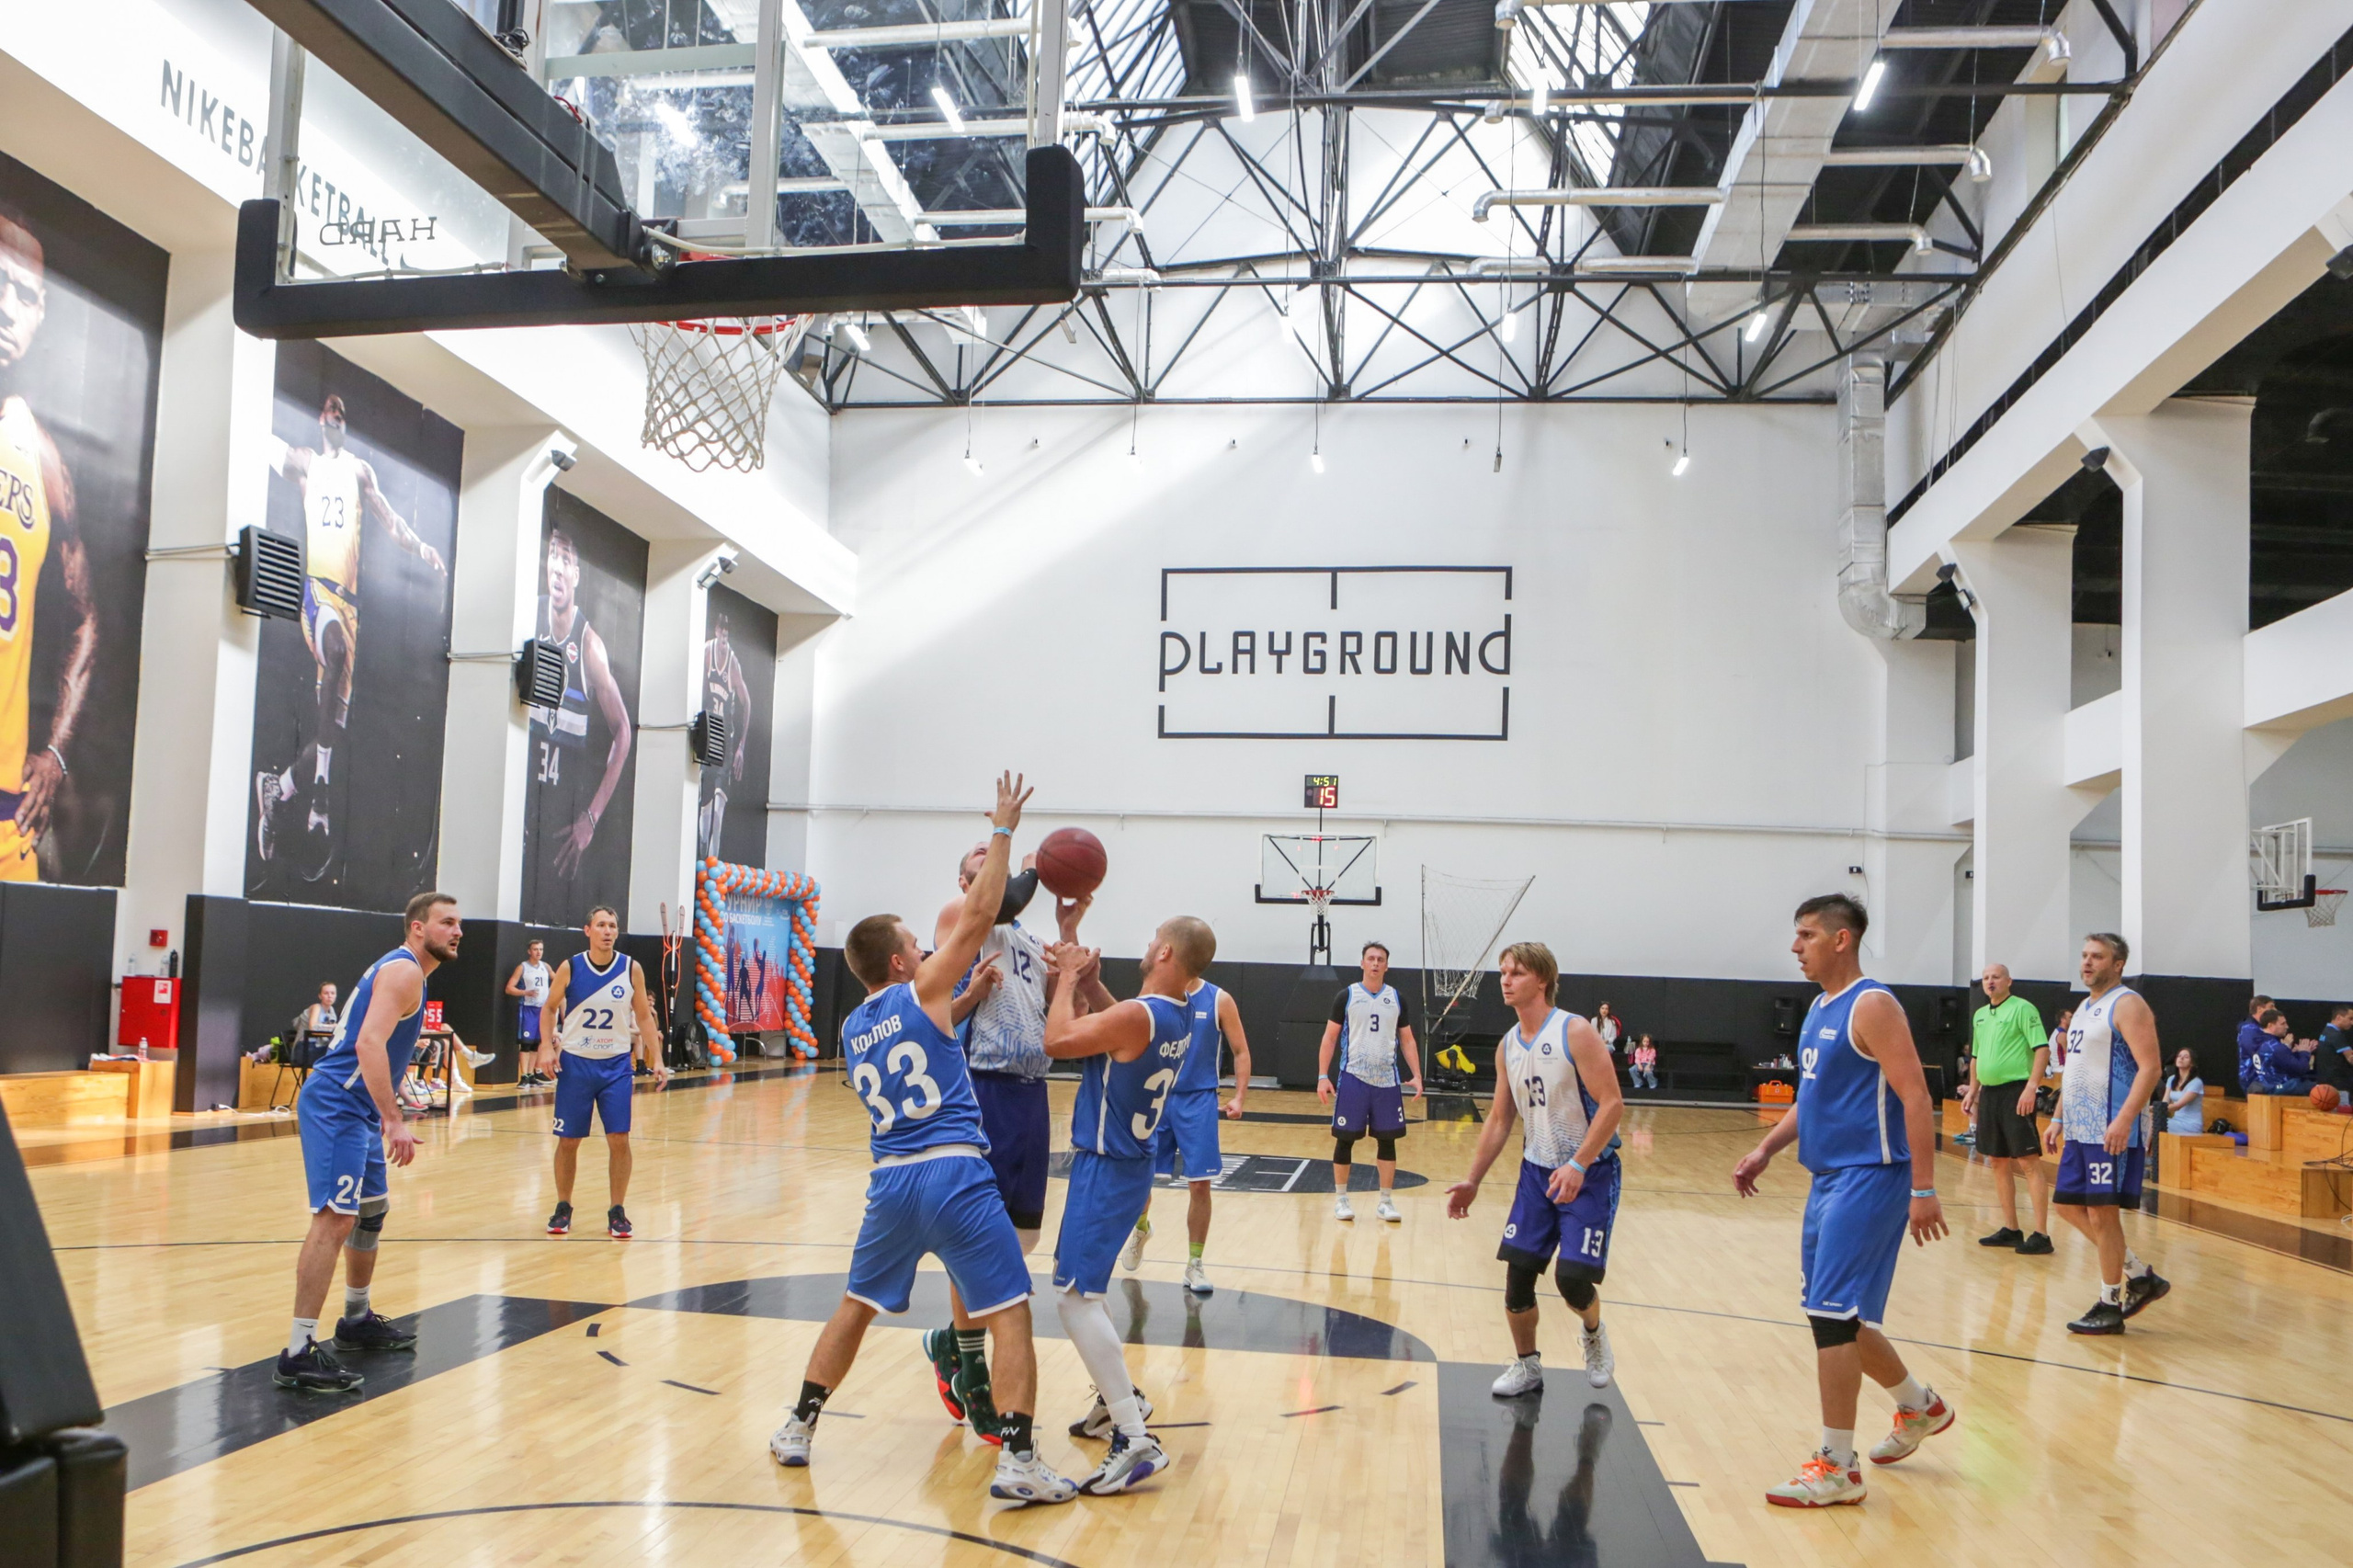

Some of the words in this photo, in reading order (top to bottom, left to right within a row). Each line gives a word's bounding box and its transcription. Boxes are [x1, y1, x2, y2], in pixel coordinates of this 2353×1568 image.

[322, 495, 345, 529] 23
[538, 741, 560, 786] 34
[1313, 776, 1337, 787] 4:51
[1319, 787, 1336, 807] 15
[727, 893, 762, 914] УРНИР
[1011, 945, 1031, 983] 12
[534, 976, 544, 987] 21
[582, 1007, 614, 1030] 22
[1370, 1014, 1380, 1032] 3
[2067, 1029, 2085, 1054] 32
[853, 1040, 942, 1136] 33
[1524, 1075, 1546, 1108] 13
[1397, 1106, 1404, 1123] 3
[2088, 1162, 2113, 1185] 32
[335, 1174, 364, 1206] 24
[1580, 1226, 1605, 1258] 13
